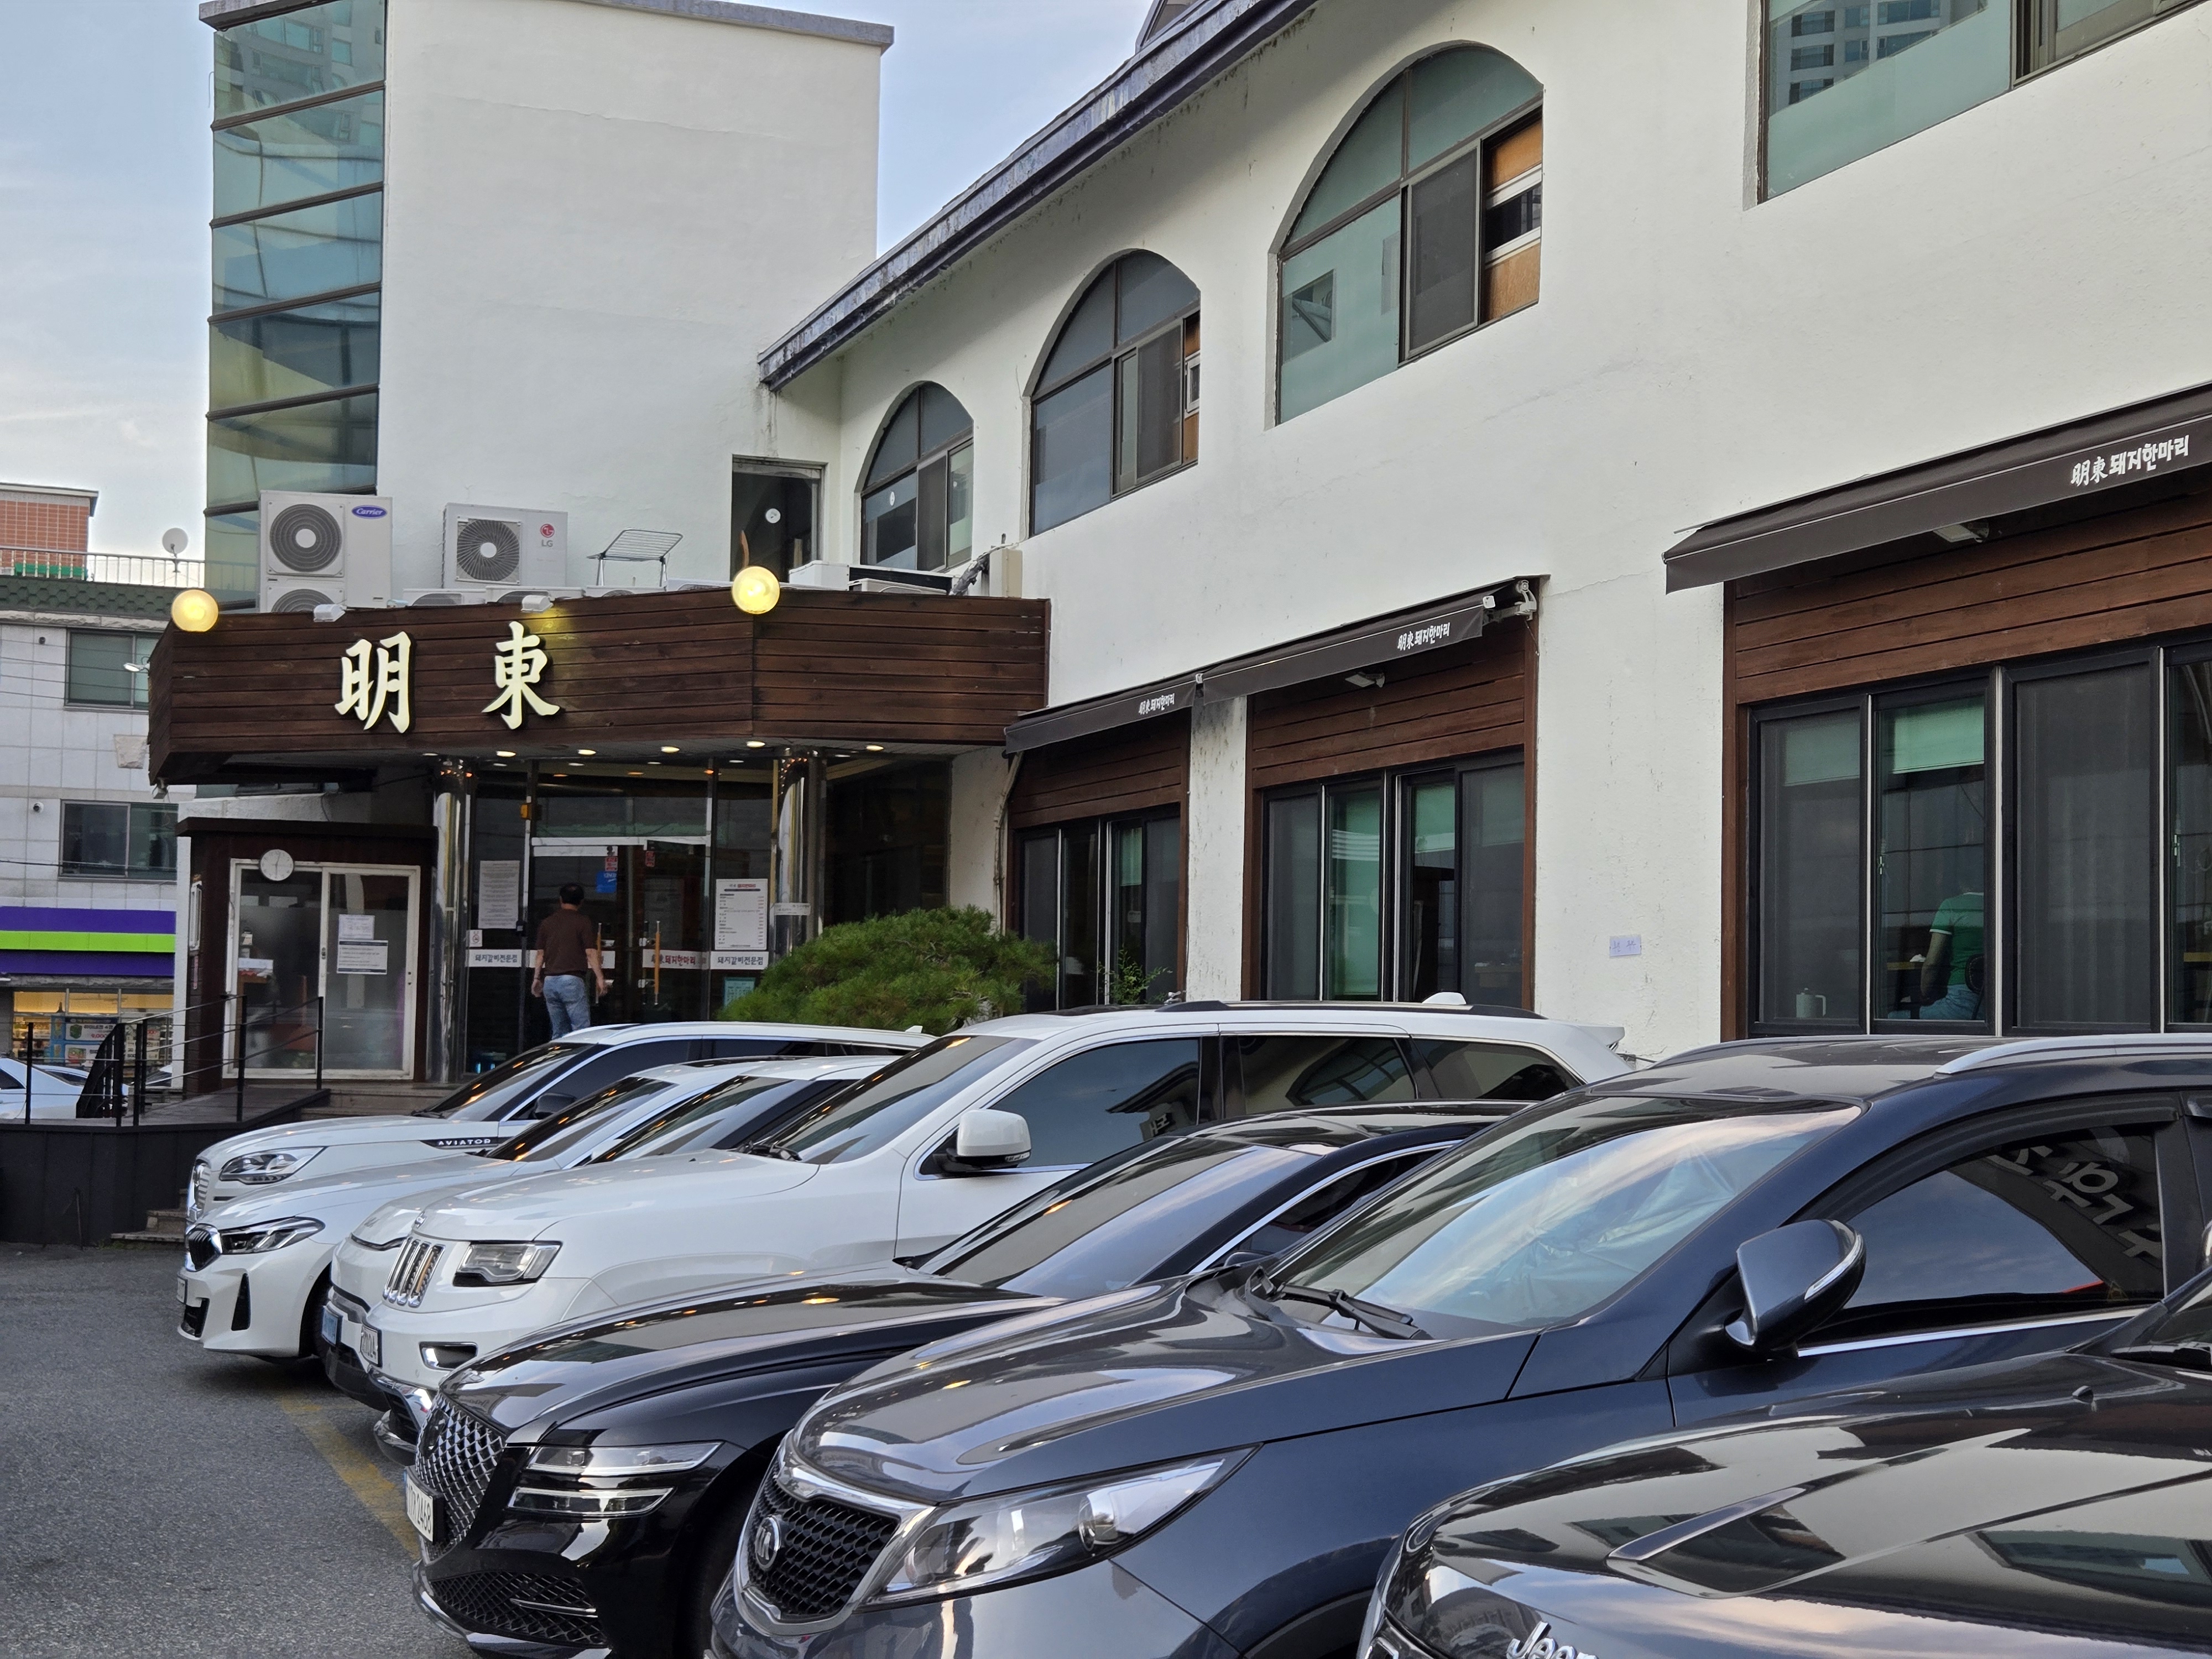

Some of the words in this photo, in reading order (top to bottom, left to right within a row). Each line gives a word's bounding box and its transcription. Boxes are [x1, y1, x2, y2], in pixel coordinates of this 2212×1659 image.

[541, 539, 554, 547] LG
[334, 620, 560, 733] 明東
[717, 956, 764, 966] 돼지갈비전문점
[1506, 1620, 1599, 1659] Jee
